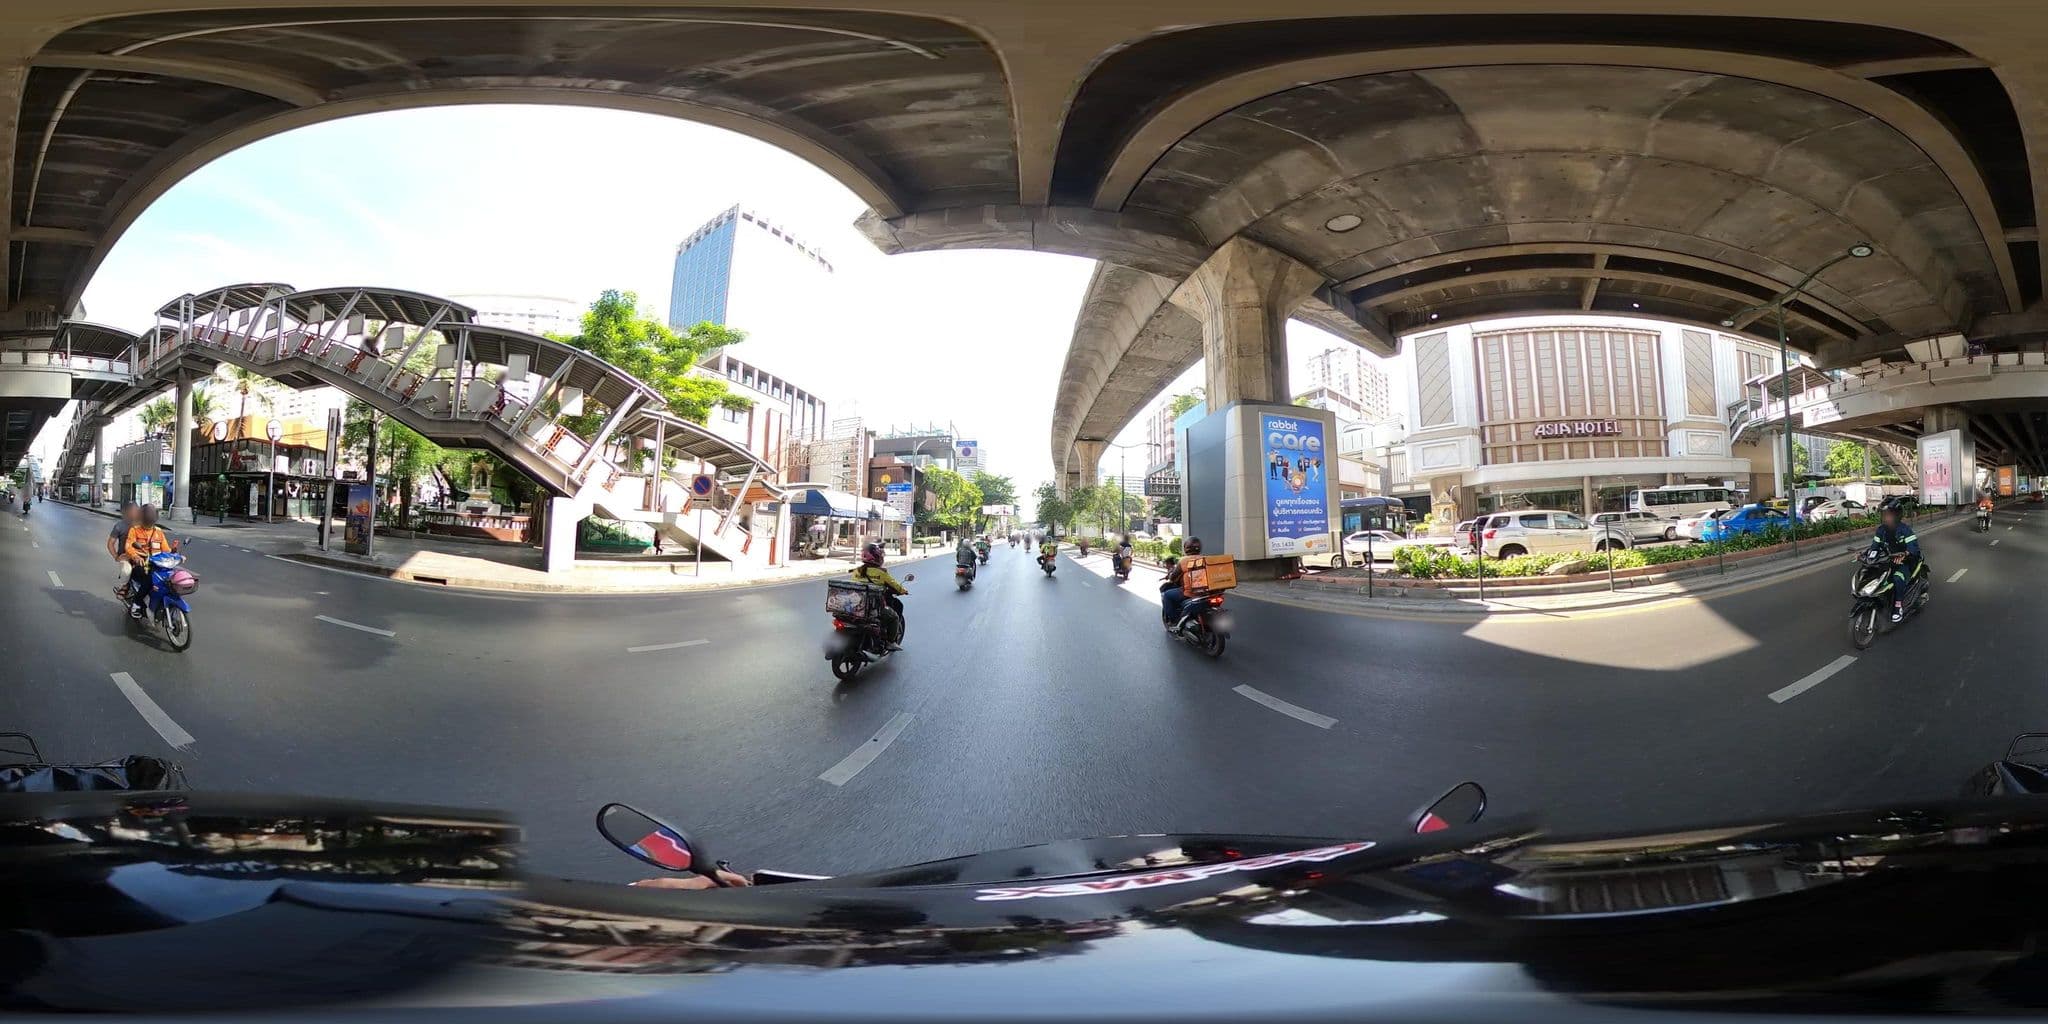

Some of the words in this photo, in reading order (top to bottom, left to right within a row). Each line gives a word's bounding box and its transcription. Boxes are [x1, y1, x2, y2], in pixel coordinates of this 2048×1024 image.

[1268, 420, 1298, 432] rabbit
[1535, 423, 1571, 436] ASIA
[1574, 421, 1622, 434] HOTEL
[1269, 432, 1320, 452] care
